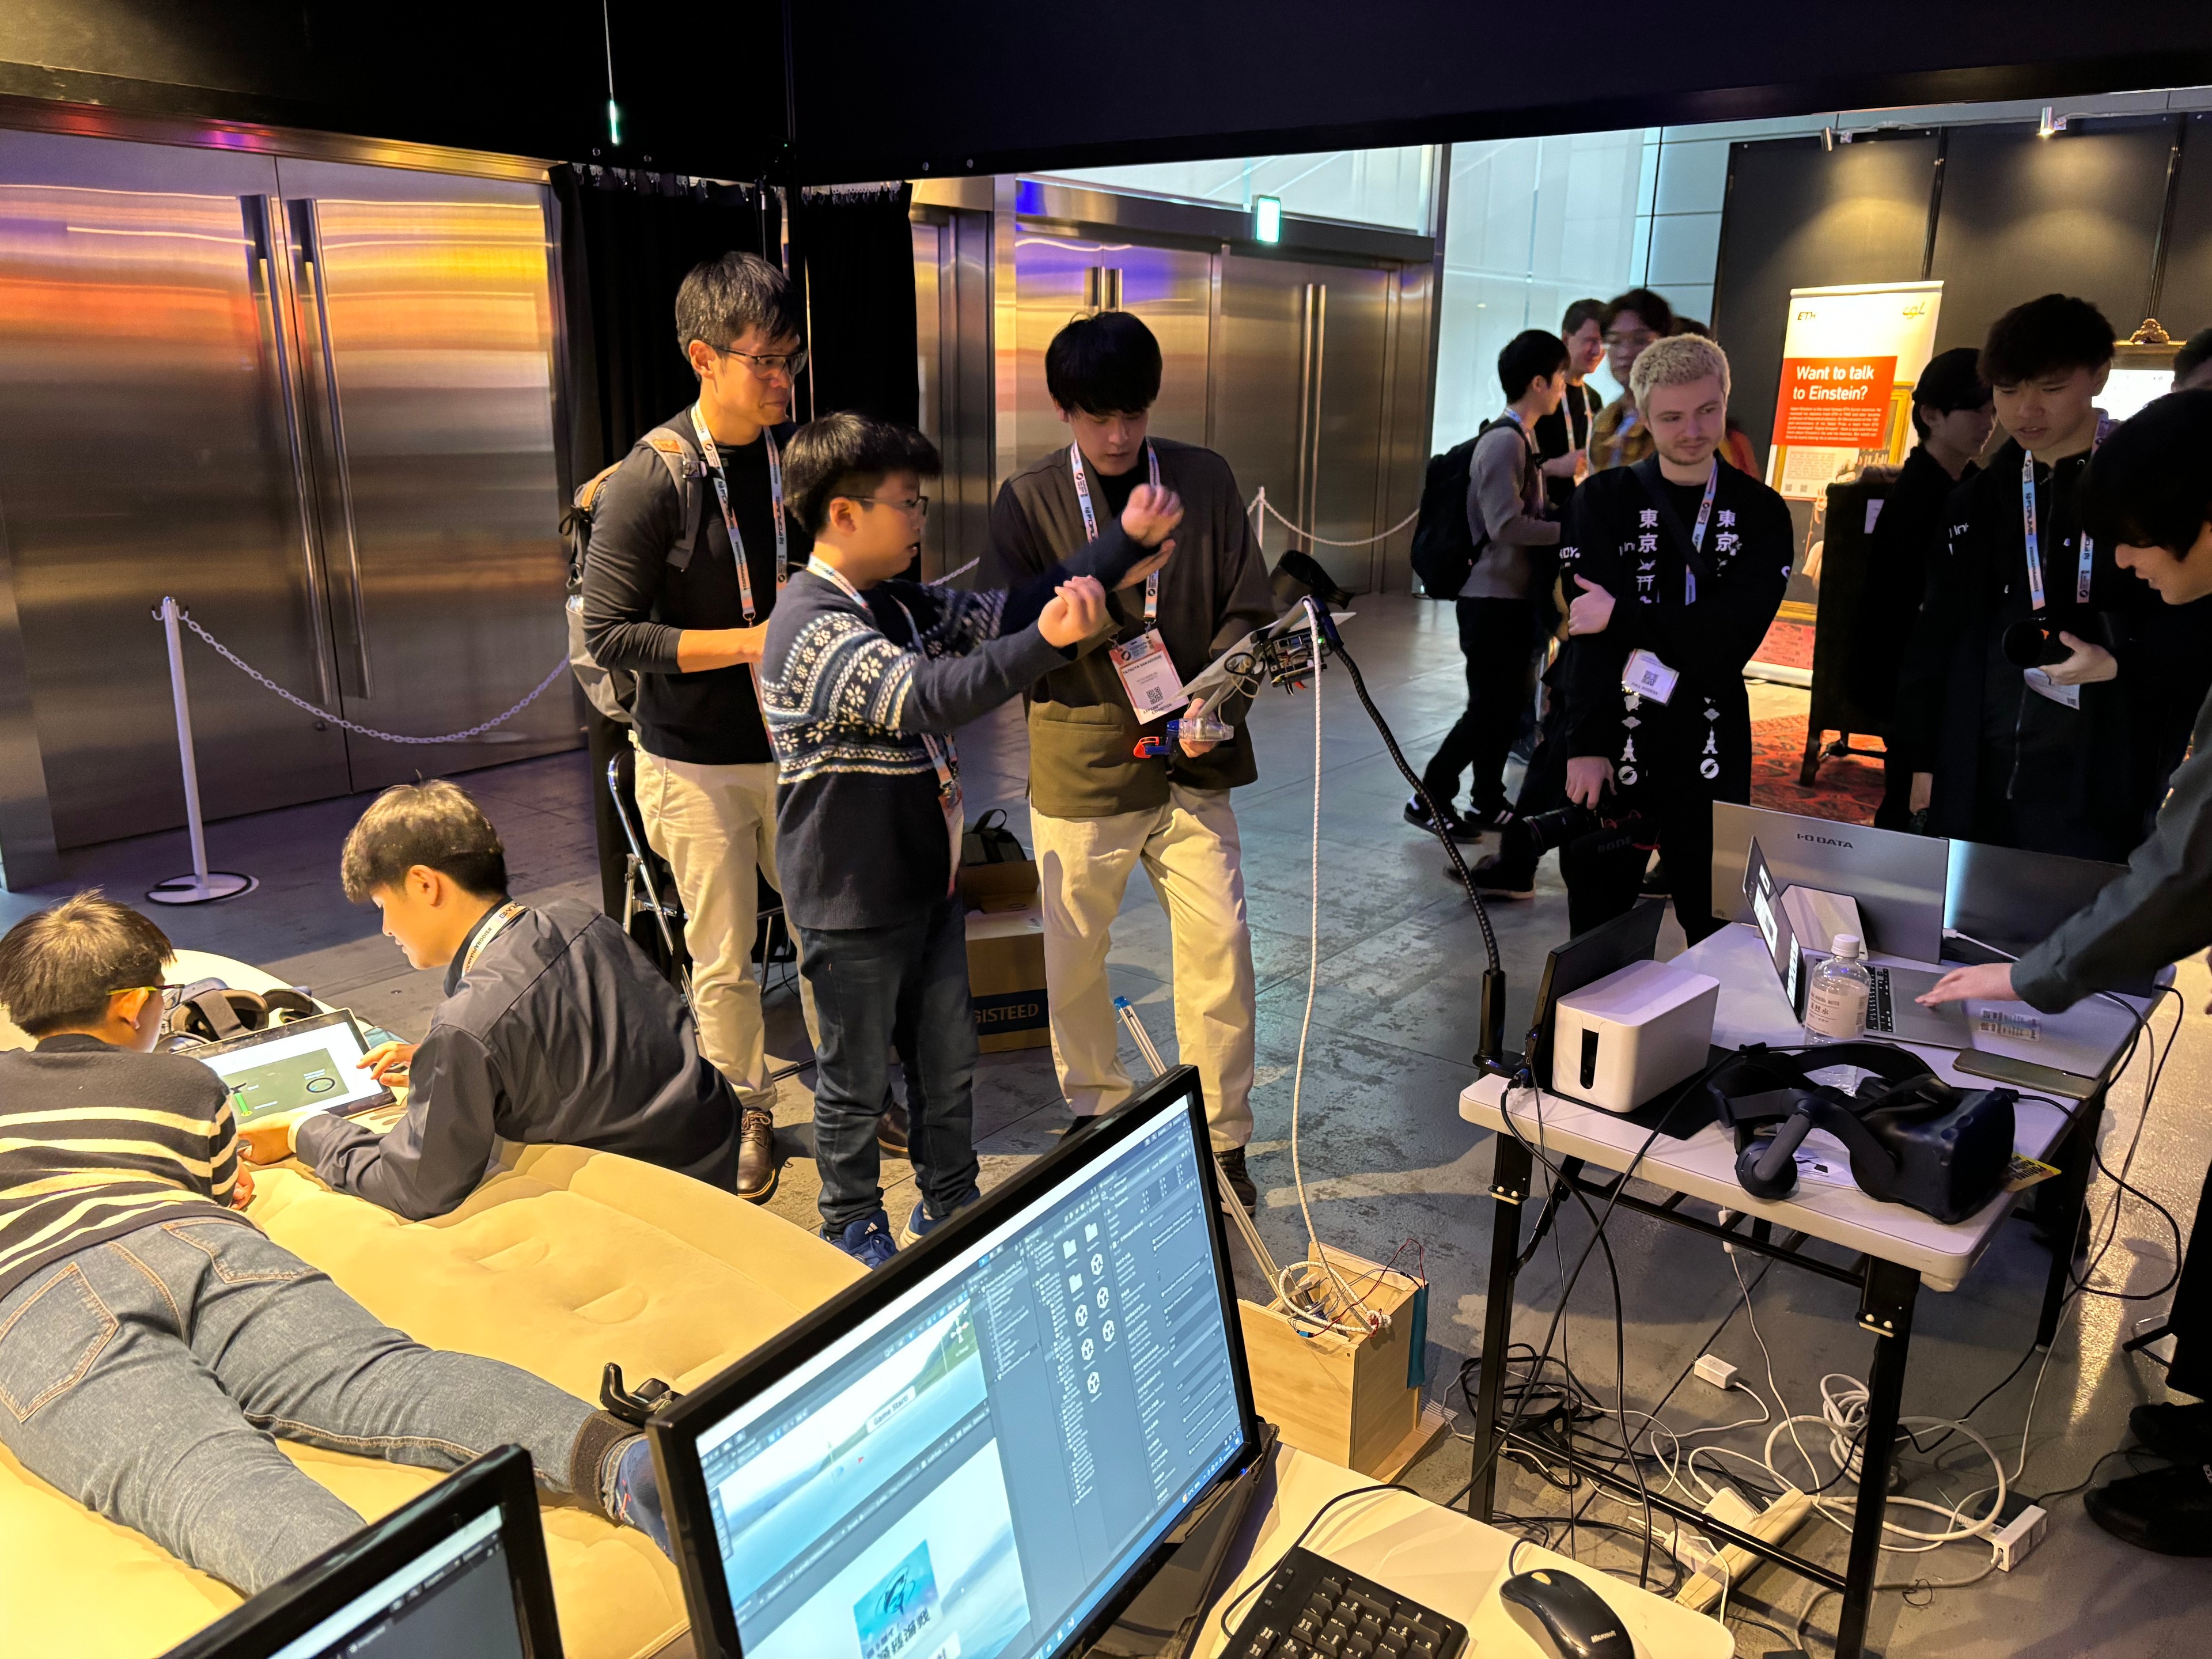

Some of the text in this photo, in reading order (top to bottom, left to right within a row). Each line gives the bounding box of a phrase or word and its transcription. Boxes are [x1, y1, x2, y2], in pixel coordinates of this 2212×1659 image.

[1797, 365, 1874, 380] Want to talk
[1793, 385, 1869, 401] to Einstein?
[1638, 508, 1659, 554] 東京
[1715, 509, 1736, 552] 東京
[1816, 836, 1854, 849] DATA
[1590, 1630, 1617, 1643] Microsoft
